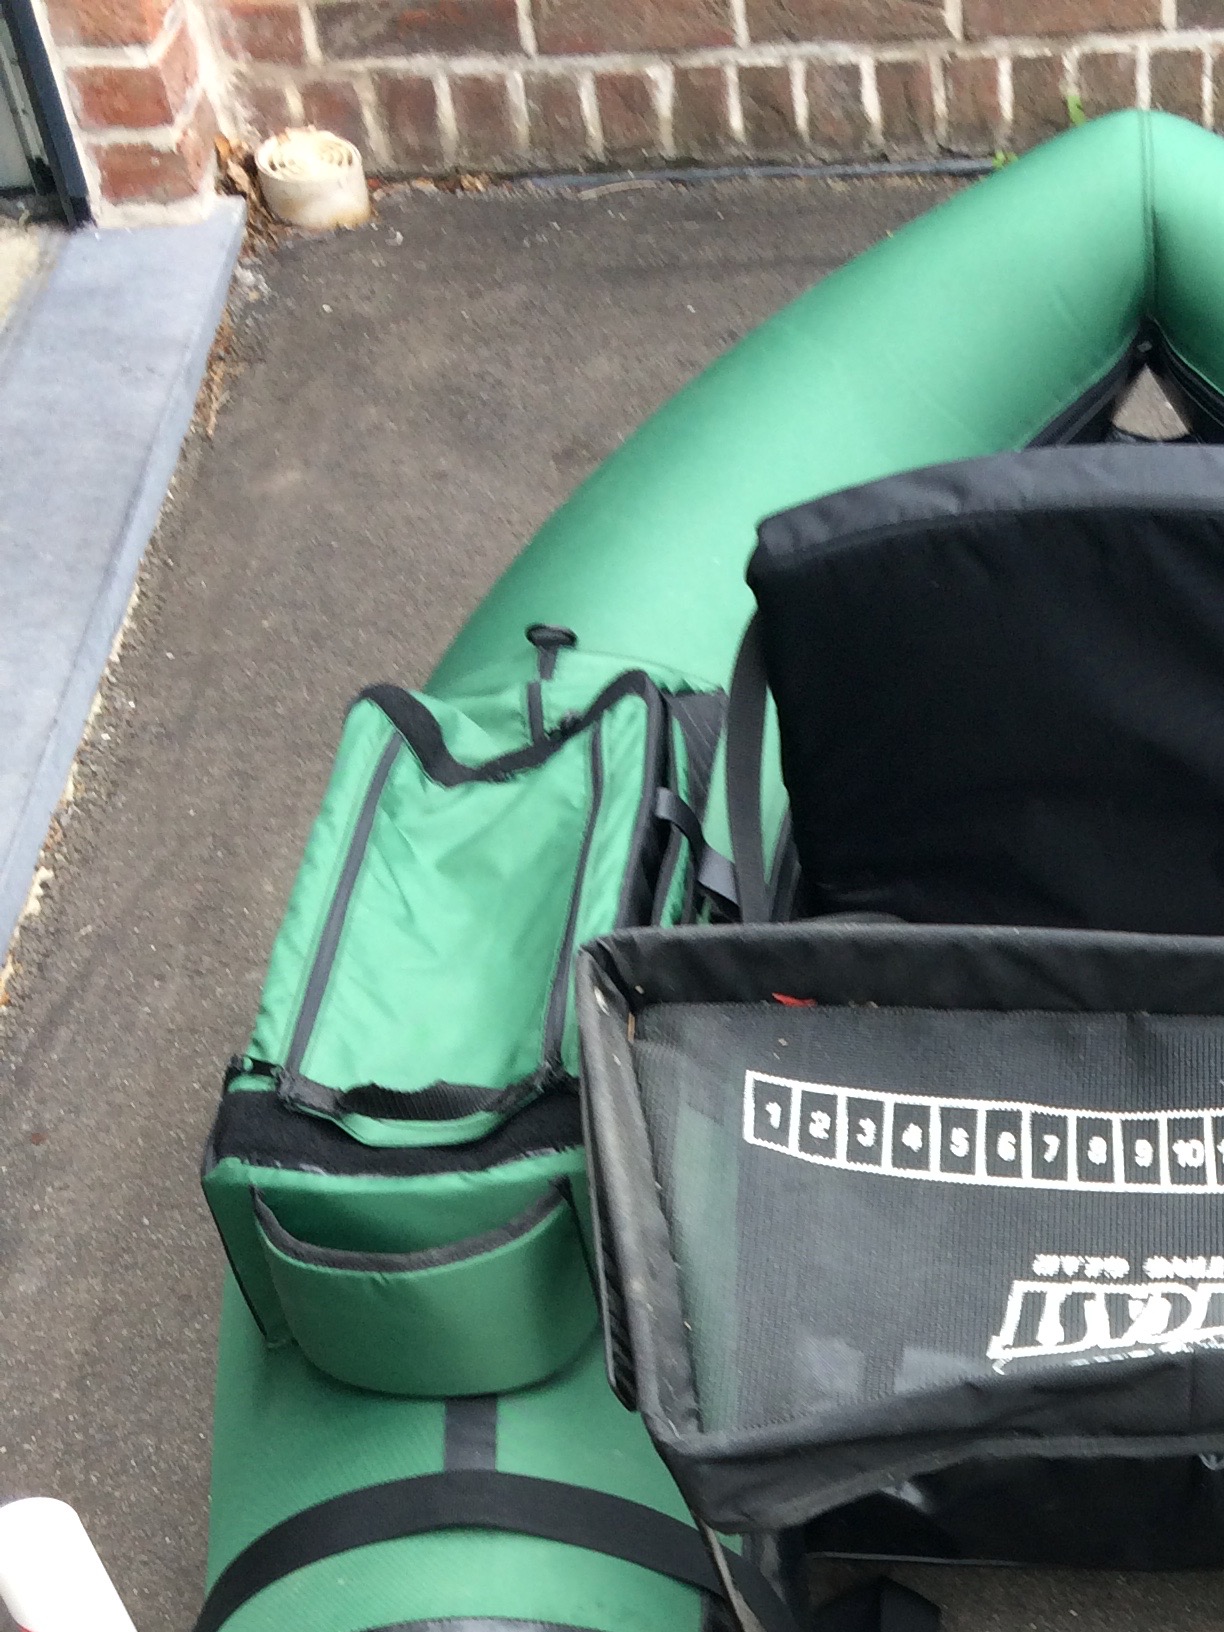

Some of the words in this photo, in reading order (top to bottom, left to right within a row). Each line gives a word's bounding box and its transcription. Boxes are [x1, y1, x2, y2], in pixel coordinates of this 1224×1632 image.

[765, 1101, 782, 1130] 1
[809, 1110, 831, 1140] 2
[856, 1117, 876, 1147] 3
[901, 1122, 922, 1153] 4
[949, 1127, 969, 1157] 5
[996, 1131, 1016, 1162] 6
[1042, 1134, 1061, 1163] 7
[1087, 1136, 1107, 1165] 8
[1134, 1138, 1154, 1168] 9
[1172, 1138, 1205, 1168] 10
